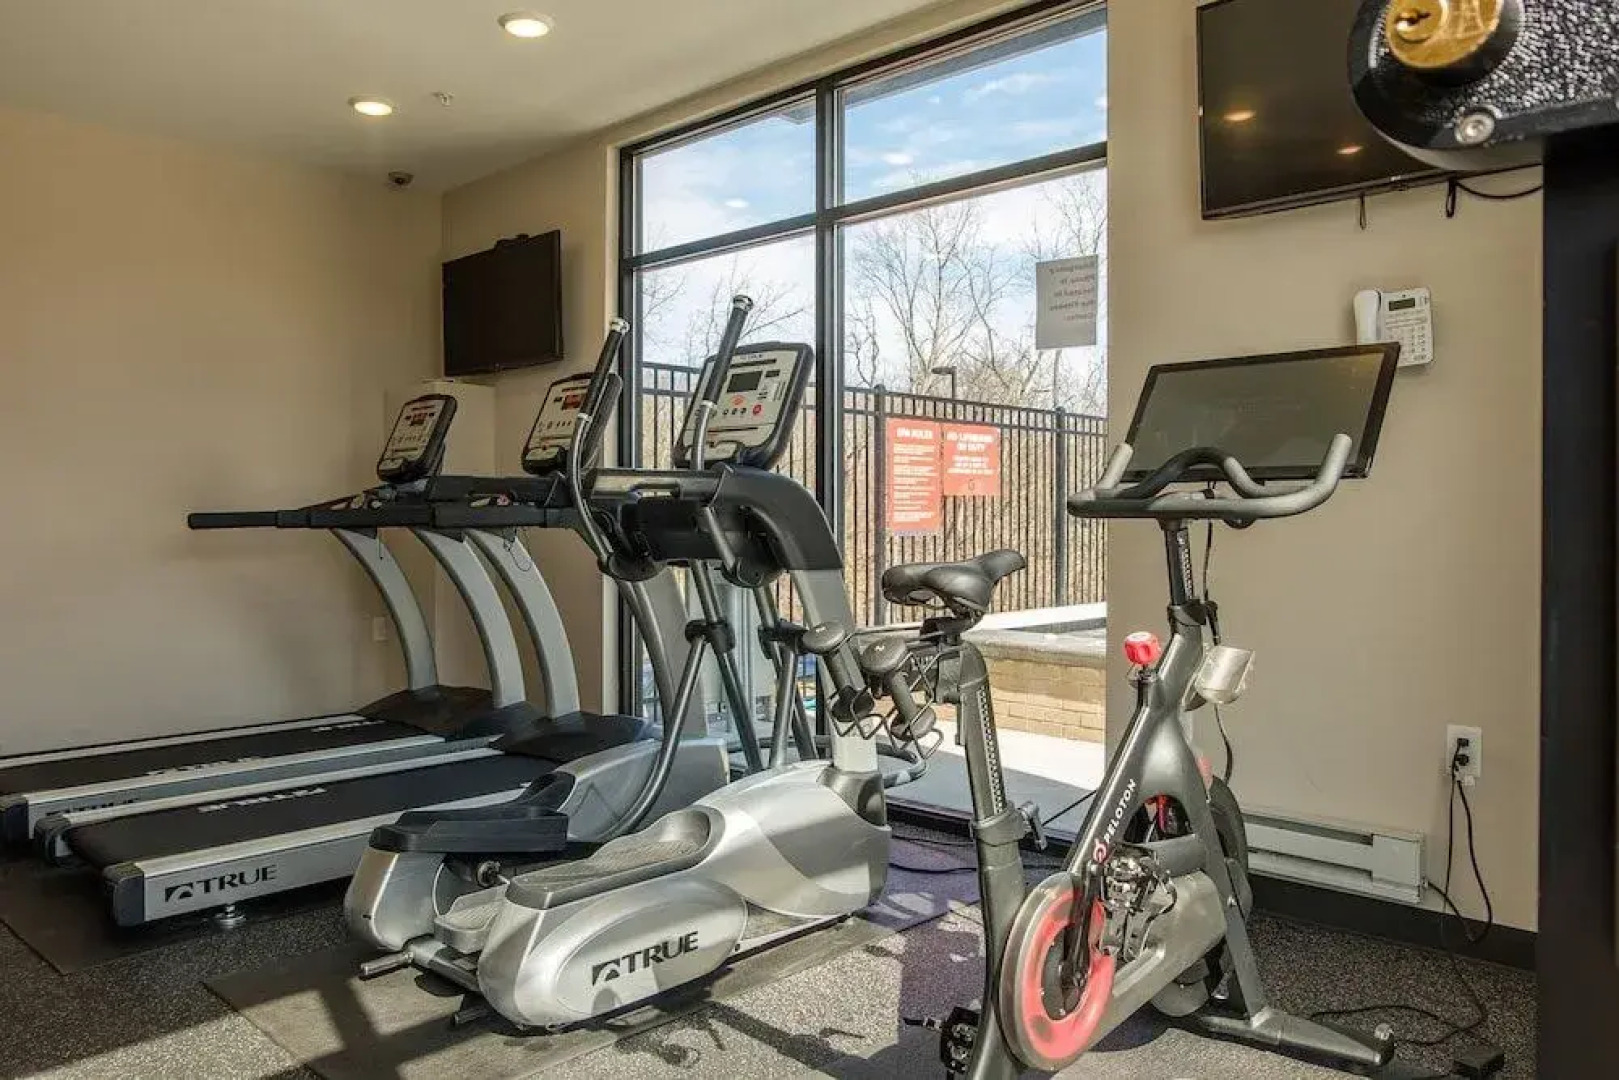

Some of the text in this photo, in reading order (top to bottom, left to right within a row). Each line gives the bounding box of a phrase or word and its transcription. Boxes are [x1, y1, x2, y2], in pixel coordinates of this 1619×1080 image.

[1103, 778, 1136, 844] PELOTON
[195, 864, 278, 894] TRUE
[621, 930, 699, 974] TRUE
